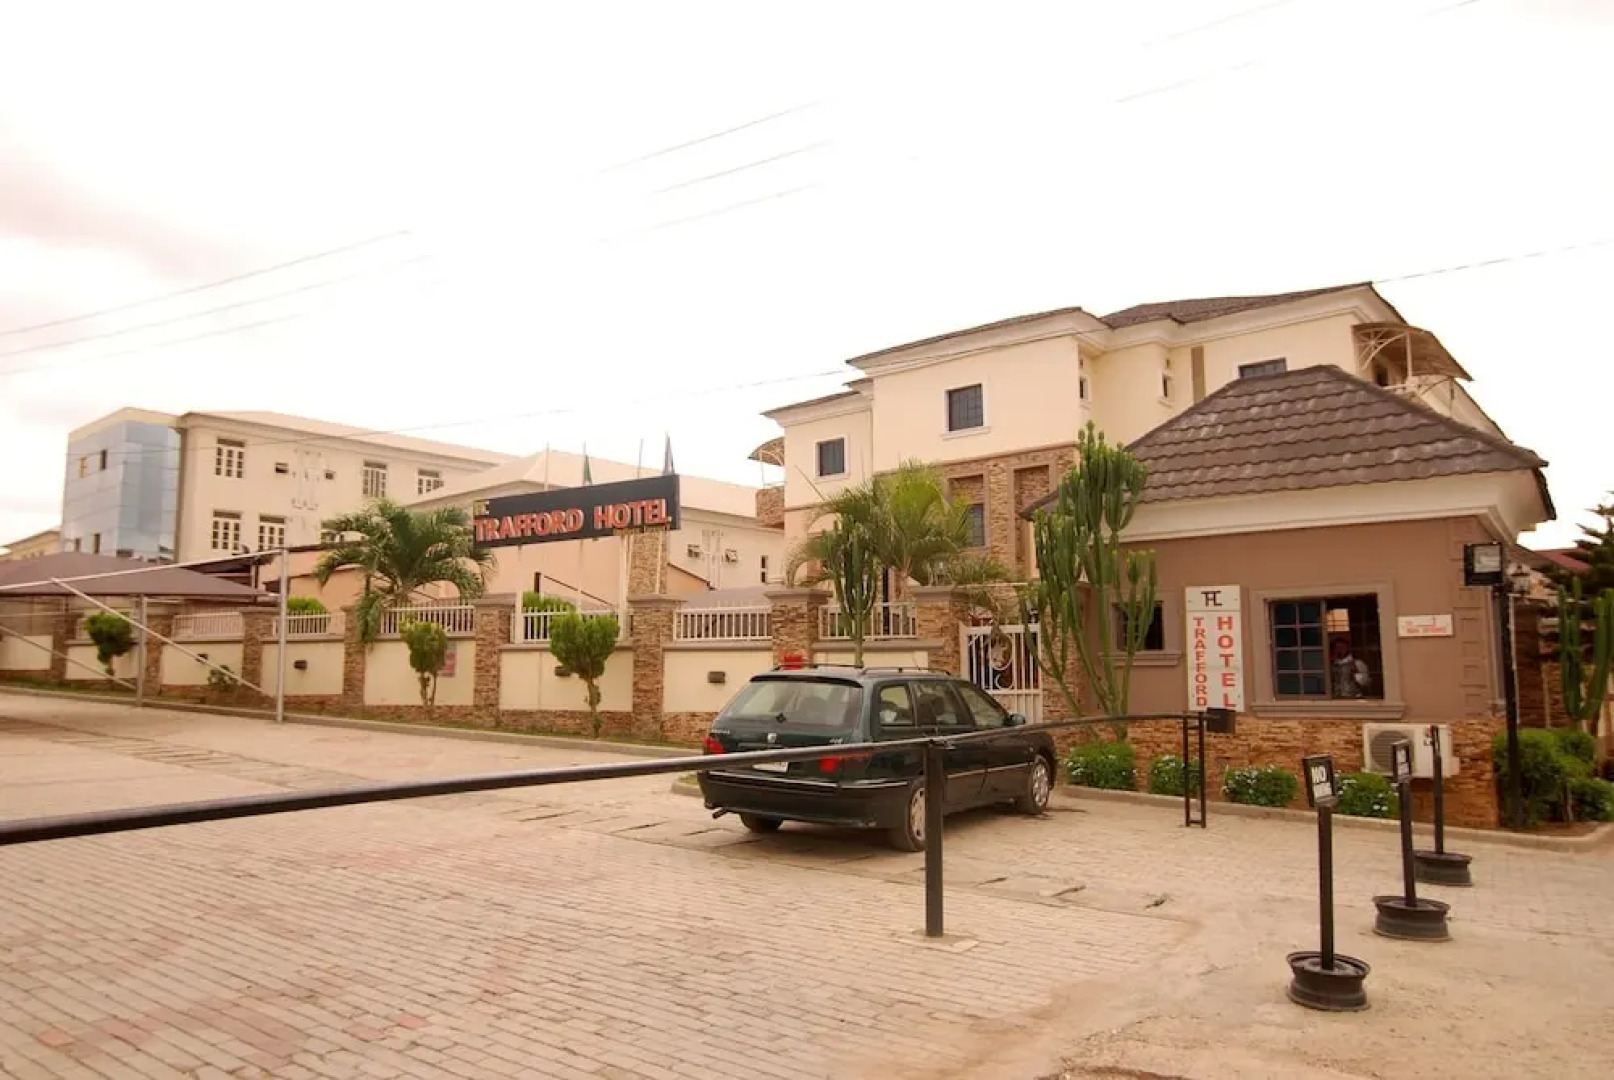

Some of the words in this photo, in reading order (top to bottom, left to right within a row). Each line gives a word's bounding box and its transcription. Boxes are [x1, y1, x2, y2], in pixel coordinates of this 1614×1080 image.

[474, 508, 584, 541] TRAFFORD
[593, 498, 668, 530] HOTEL
[1193, 617, 1207, 706] TRAFFORD
[1217, 616, 1236, 708] HOTEL
